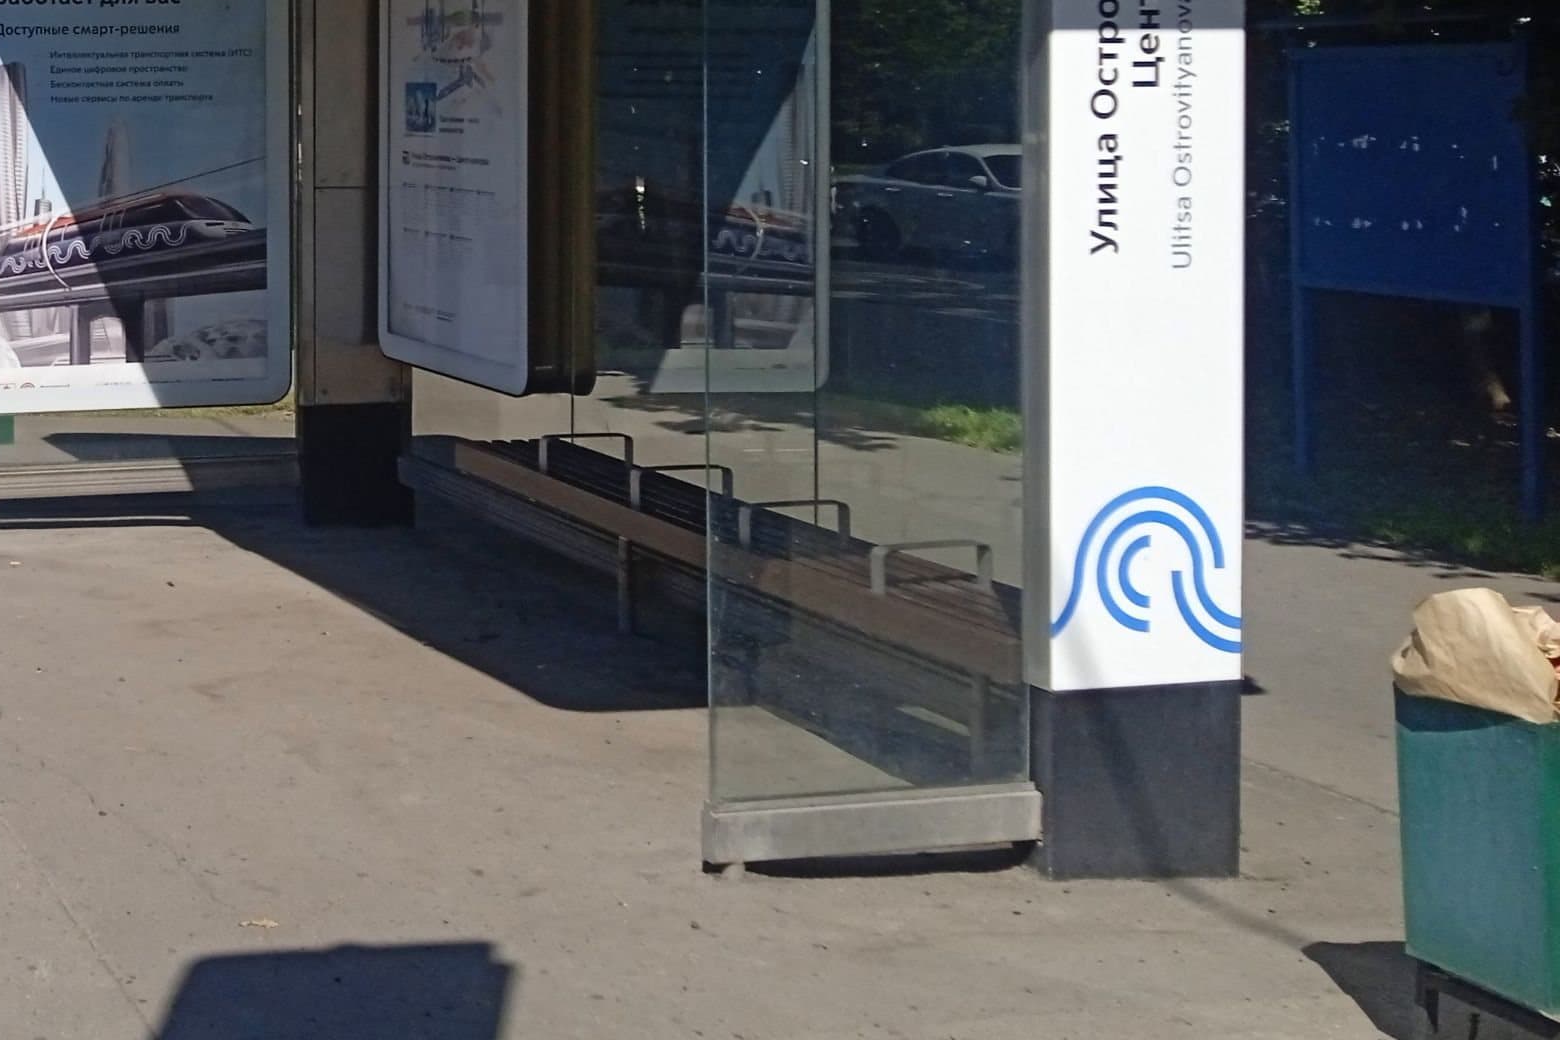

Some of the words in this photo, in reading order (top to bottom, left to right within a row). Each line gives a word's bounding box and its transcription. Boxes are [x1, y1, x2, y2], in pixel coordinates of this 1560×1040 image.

[73, 23, 180, 38] смарт-решения
[1090, 133, 1123, 255] Улица
[1171, 195, 1193, 269] Ulitsa
